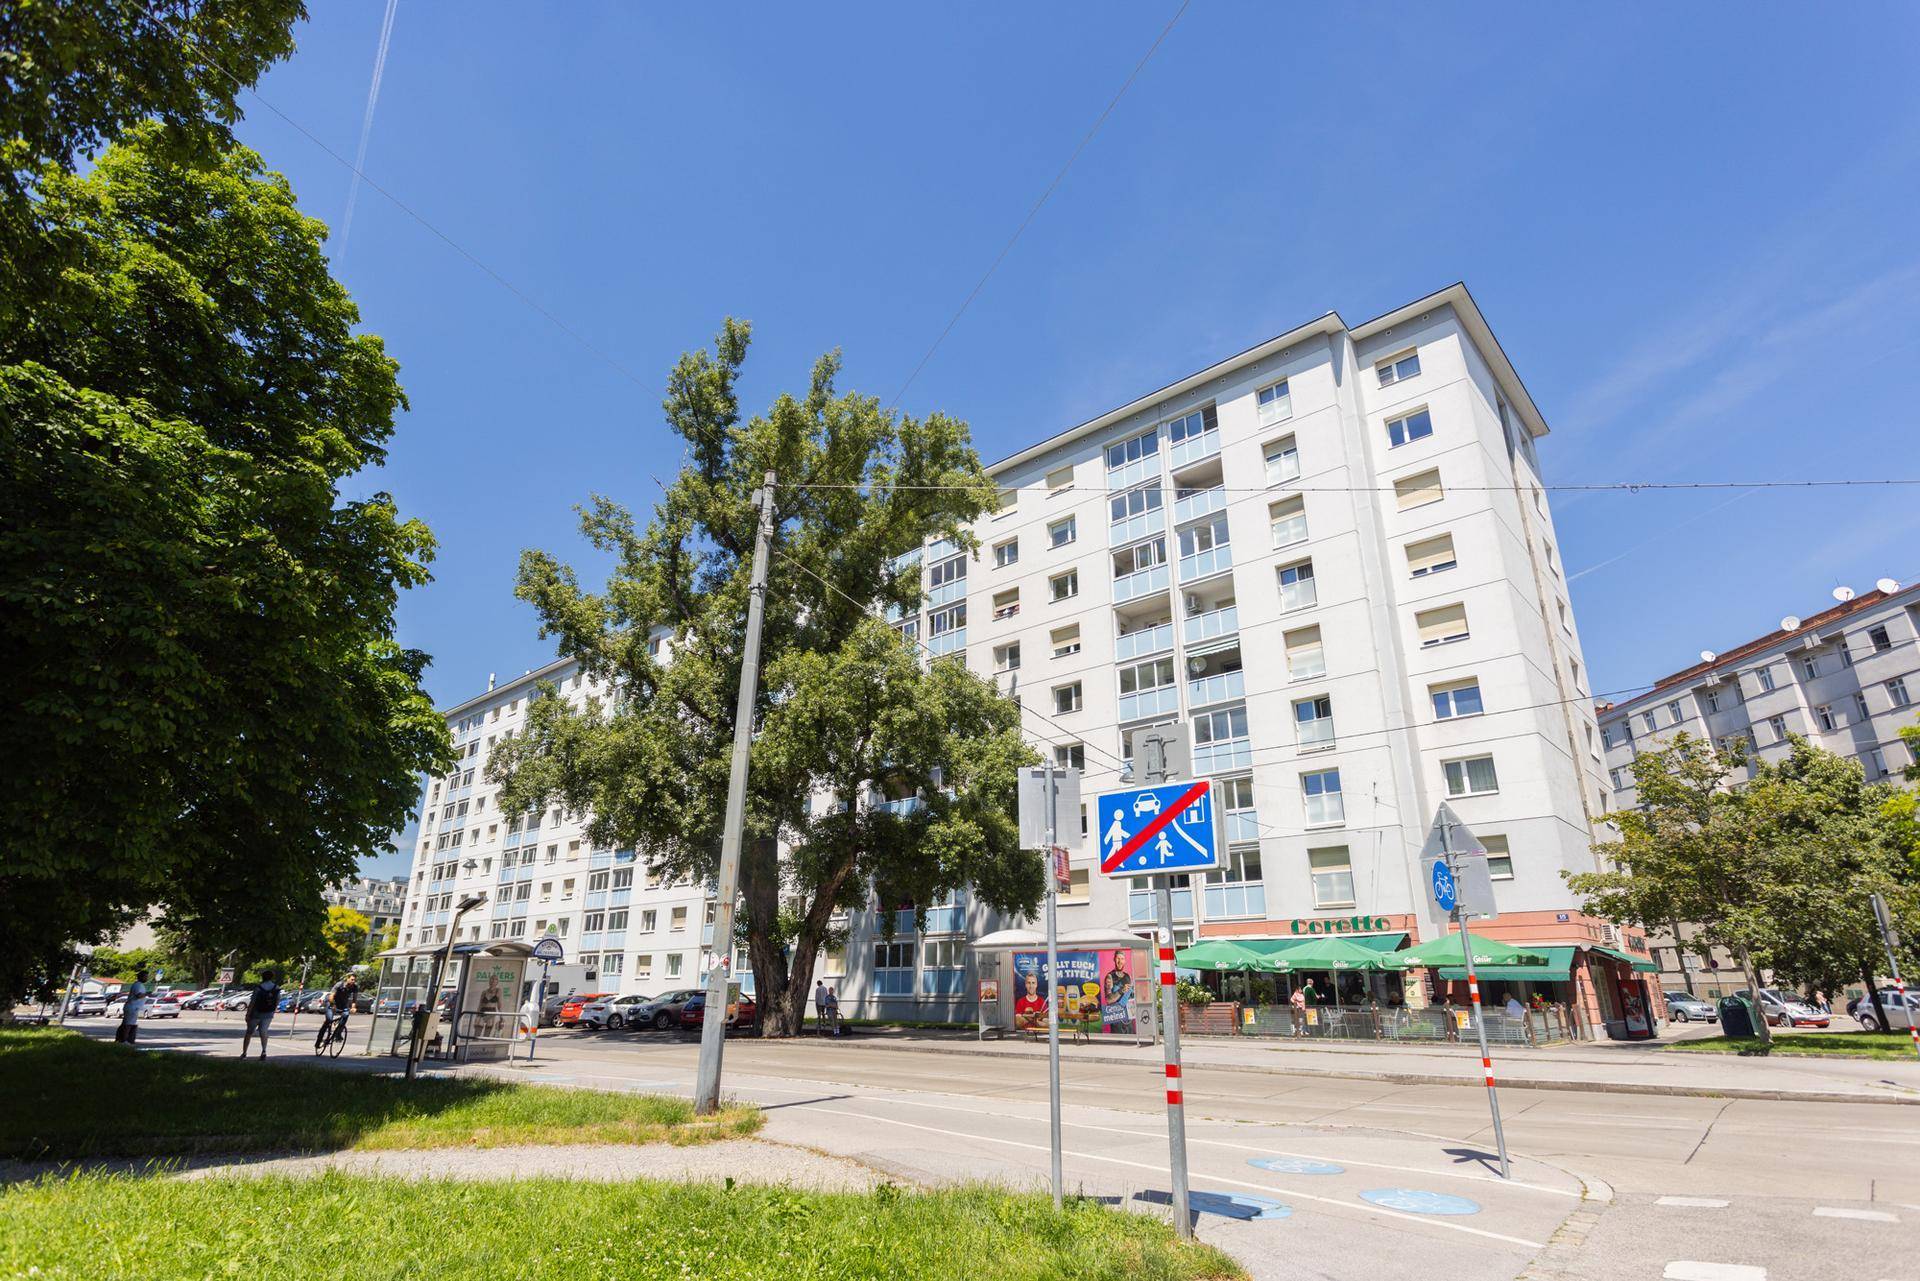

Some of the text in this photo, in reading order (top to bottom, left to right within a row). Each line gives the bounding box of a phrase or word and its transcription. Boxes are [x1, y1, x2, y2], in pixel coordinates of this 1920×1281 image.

[1290, 915, 1391, 935] Coretto
[1042, 960, 1095, 972] GLLT EUCH
